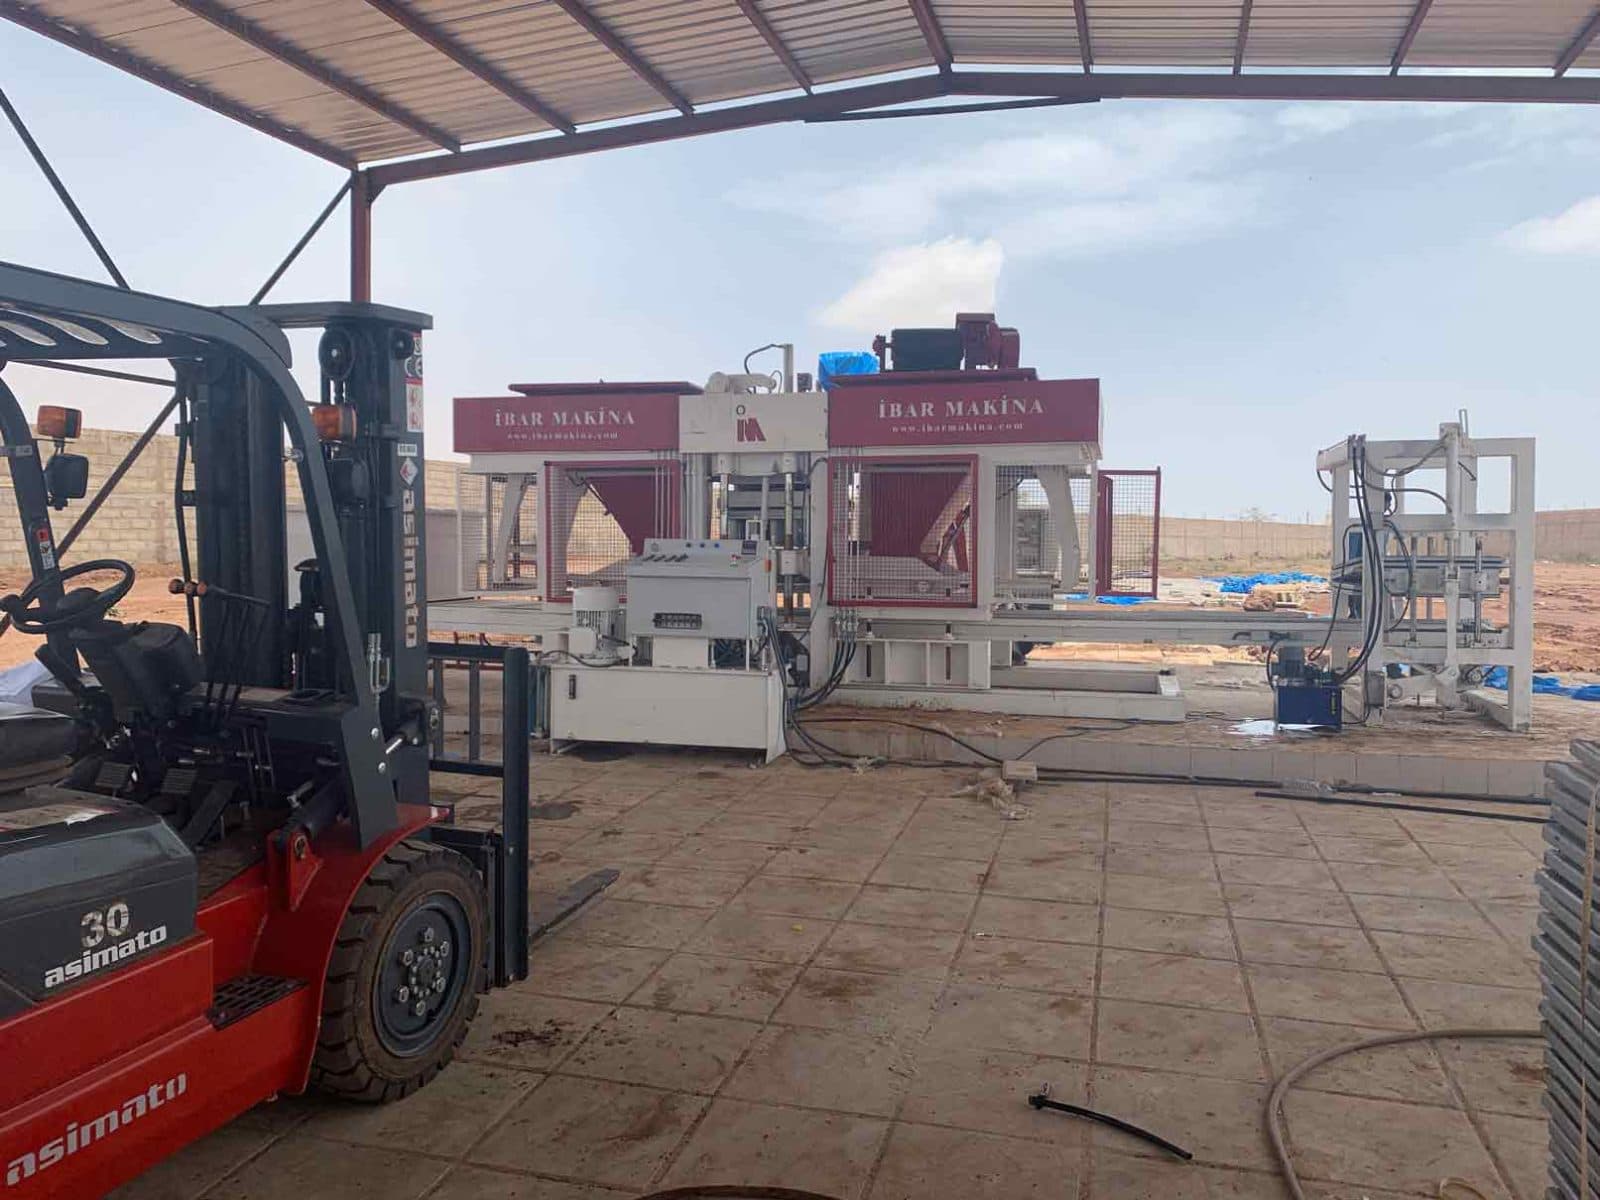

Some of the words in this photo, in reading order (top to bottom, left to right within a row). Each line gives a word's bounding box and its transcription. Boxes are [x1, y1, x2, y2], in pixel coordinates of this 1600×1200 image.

[403, 489, 419, 649] asimato
[44, 925, 168, 989] asimato
[81, 901, 129, 948] 30
[6, 1073, 187, 1186] asimato
